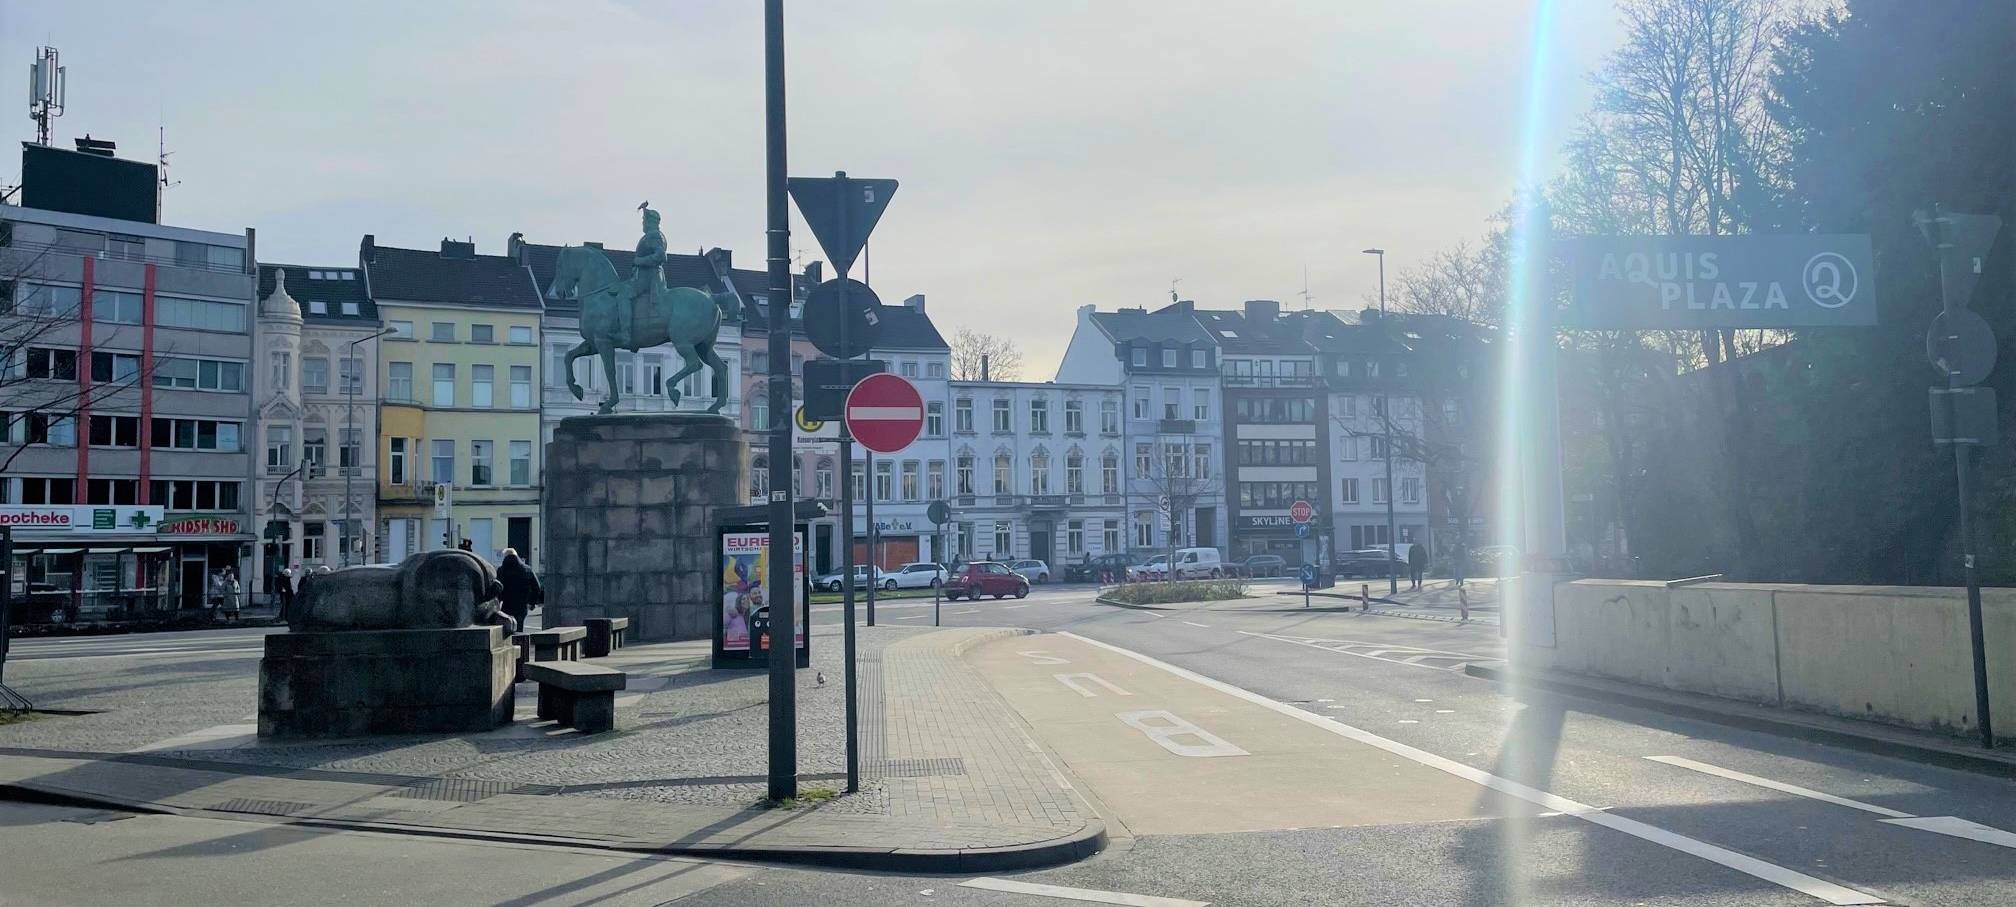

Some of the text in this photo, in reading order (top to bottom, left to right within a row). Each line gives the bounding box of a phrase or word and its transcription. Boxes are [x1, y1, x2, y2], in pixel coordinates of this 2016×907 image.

[1598, 252, 1720, 288] AQUIS
[1661, 281, 1790, 310] PLAZA
[1252, 516, 1291, 526] SKYLINE
[1292, 507, 1311, 517] STOP
[1016, 650, 1252, 758] BUS
